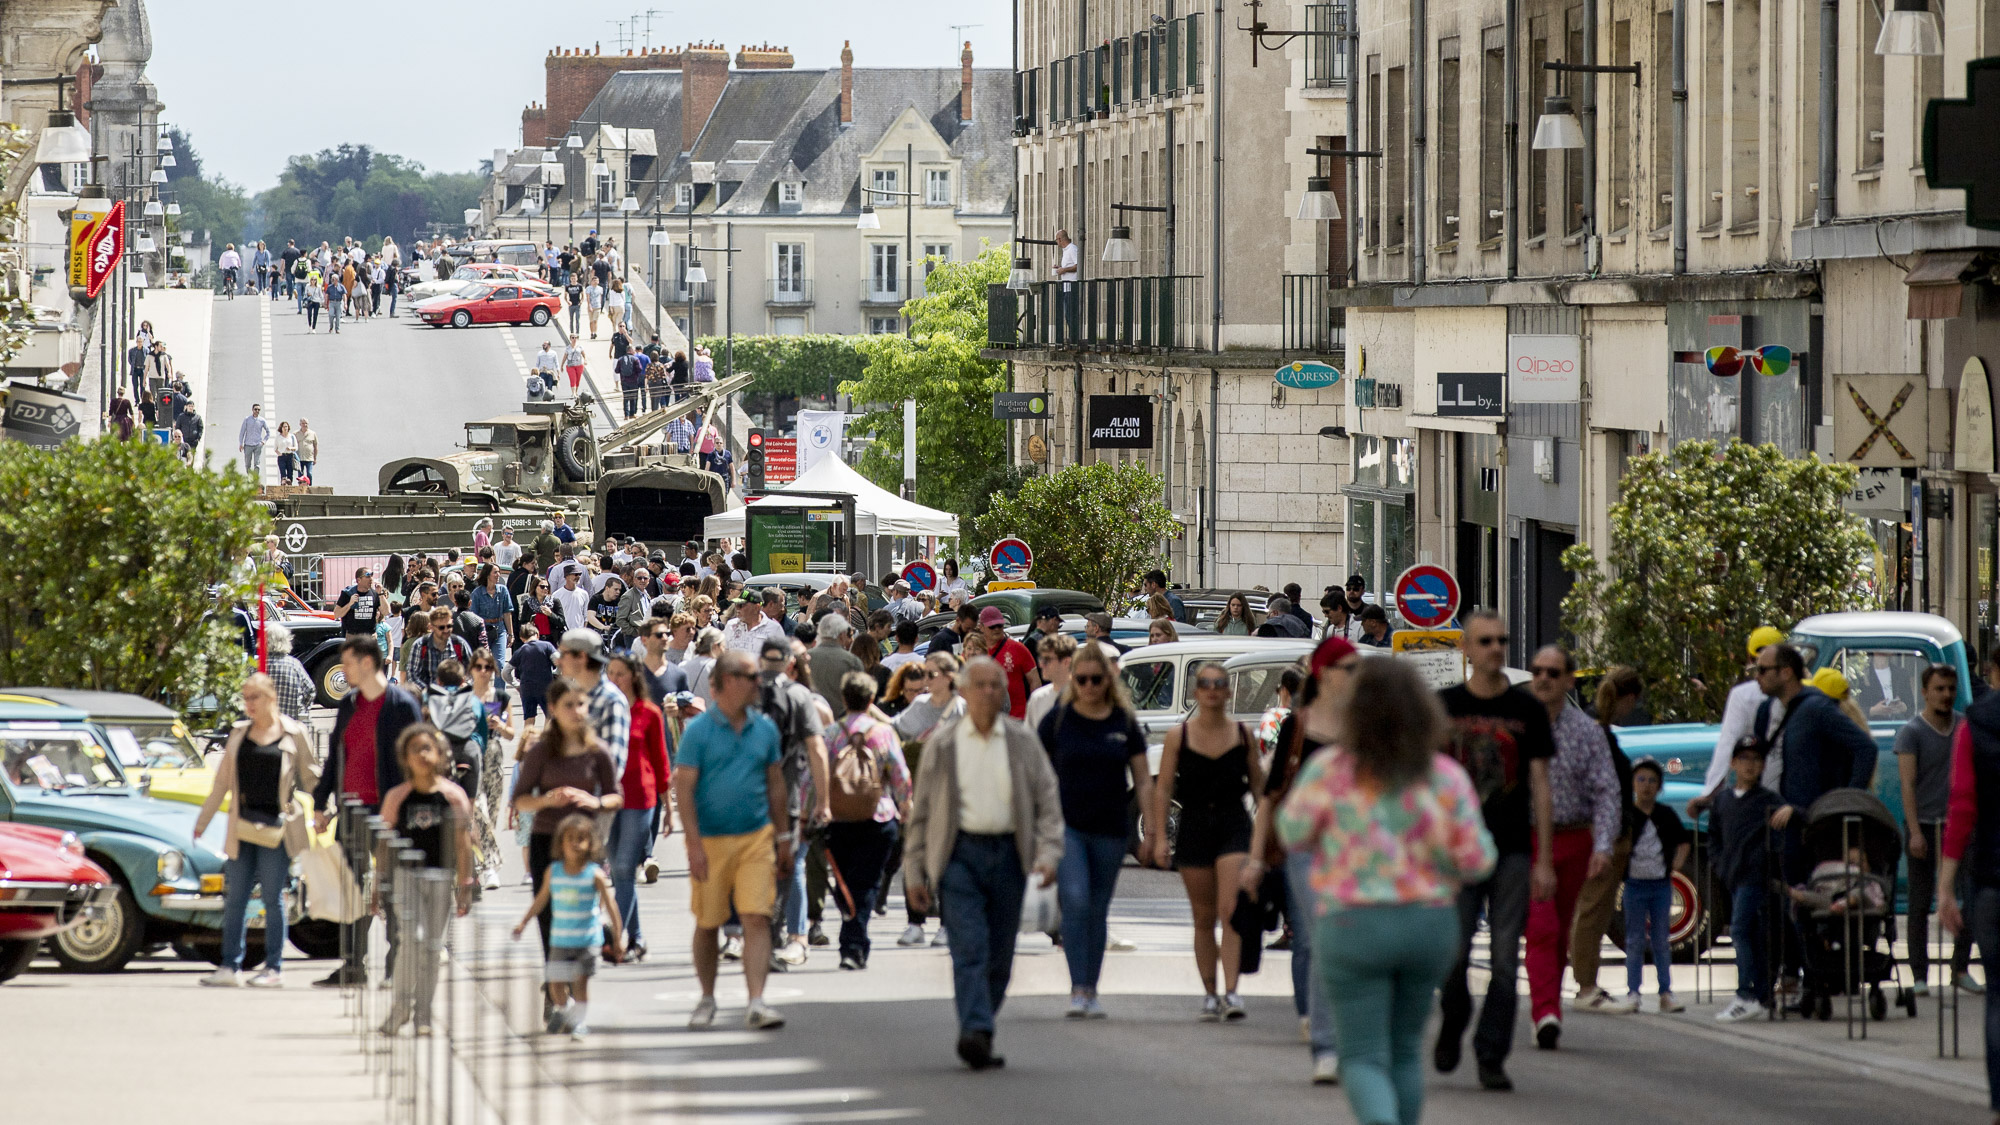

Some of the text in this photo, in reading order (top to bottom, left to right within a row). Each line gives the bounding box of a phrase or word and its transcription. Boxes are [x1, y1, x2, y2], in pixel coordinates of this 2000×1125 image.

[94, 225, 119, 273] TABAC
[73, 250, 83, 285] PRESSE
[1516, 356, 1575, 374] Qipao
[1437, 383, 1502, 409] LL by...
[14, 403, 47, 420] FDJ
[1109, 417, 1140, 428] ALAIN
[1092, 427, 1140, 438] AFFLELOU
